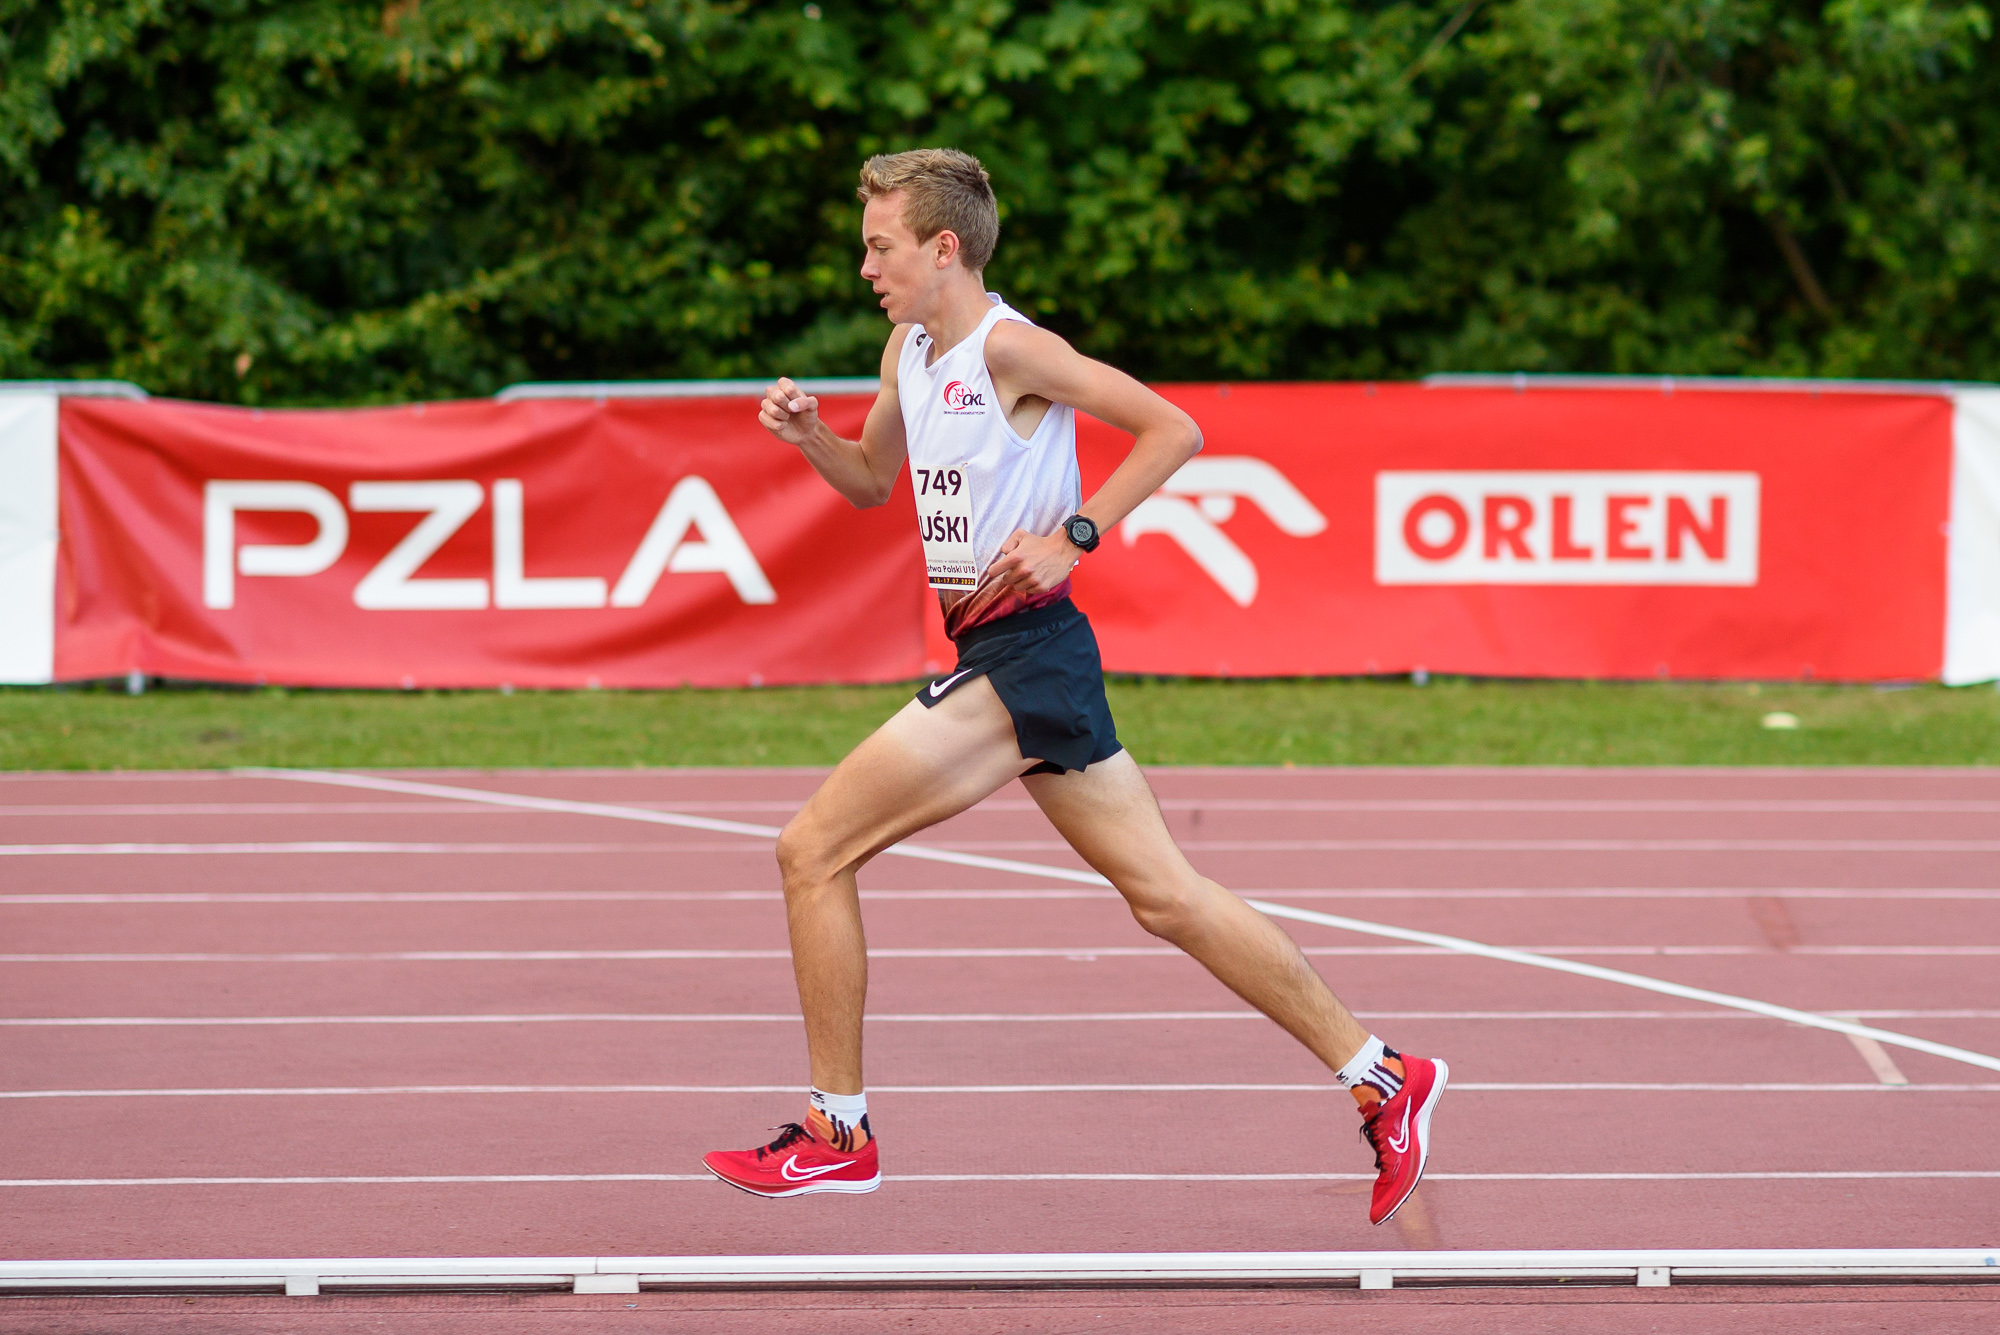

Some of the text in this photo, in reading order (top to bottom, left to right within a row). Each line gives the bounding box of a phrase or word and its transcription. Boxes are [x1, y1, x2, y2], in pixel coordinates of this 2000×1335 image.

[962, 393, 986, 406] OKL
[917, 469, 962, 496] 749
[1402, 494, 1727, 561] ORLEN
[203, 476, 777, 610] PZLA
[943, 565, 962, 574] Polski
[963, 565, 976, 574] U18
